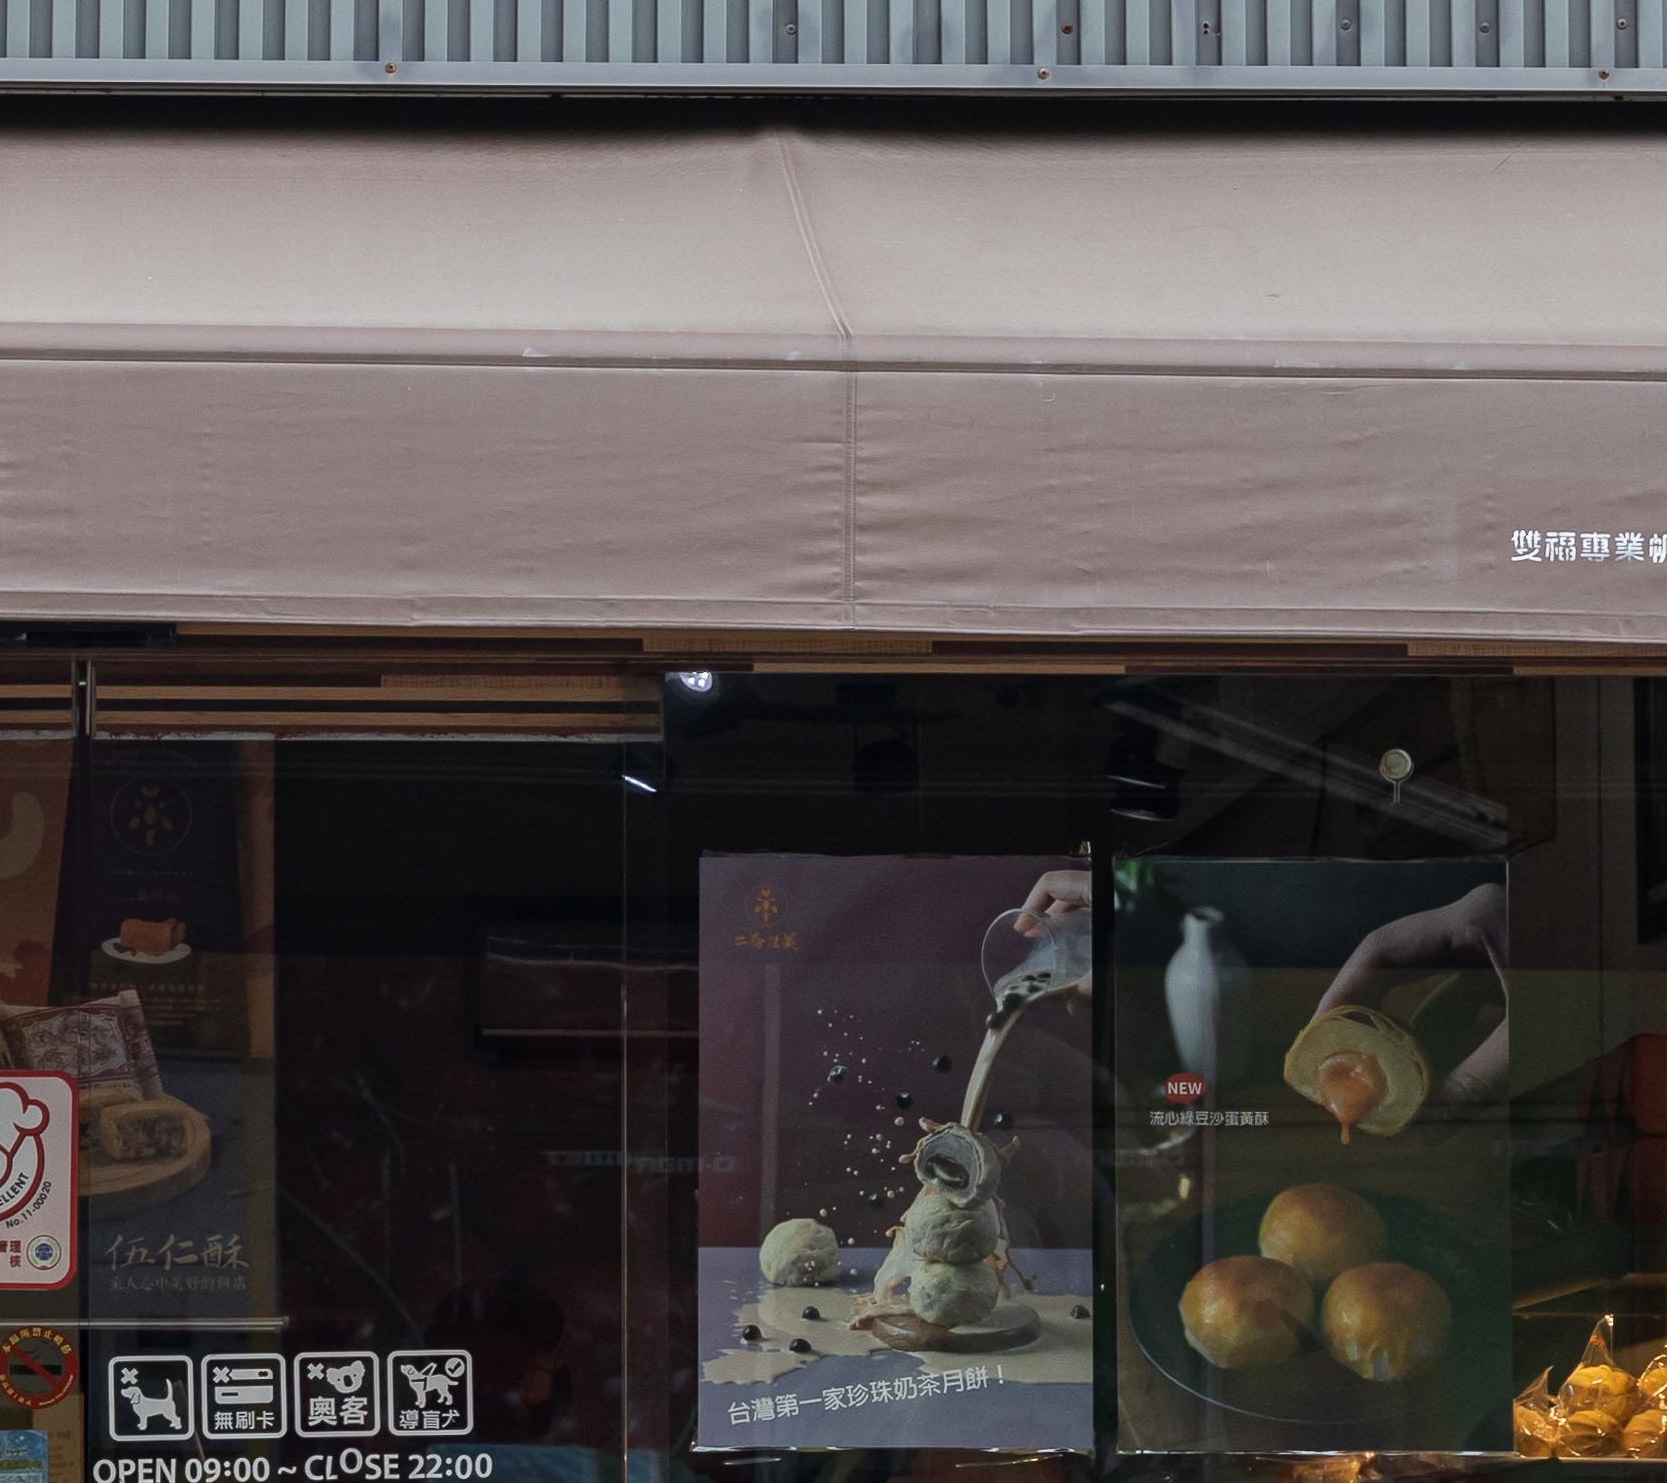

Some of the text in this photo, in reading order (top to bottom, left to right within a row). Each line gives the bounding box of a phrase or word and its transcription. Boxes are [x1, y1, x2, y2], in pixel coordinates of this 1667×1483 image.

[1167, 1081, 1203, 1096] NEW
[1149, 1109, 1271, 1127] 流心綠豆沙蛋黃酥
[104, 1233, 250, 1272] 伍仁酥
[213, 1409, 276, 1431] 無刷卡
[307, 1395, 369, 1427] 奧客
[398, 1407, 461, 1431] 導盲犬
[303, 1446, 401, 1483] CLOSE
[407, 1452, 494, 1480] 22:00
